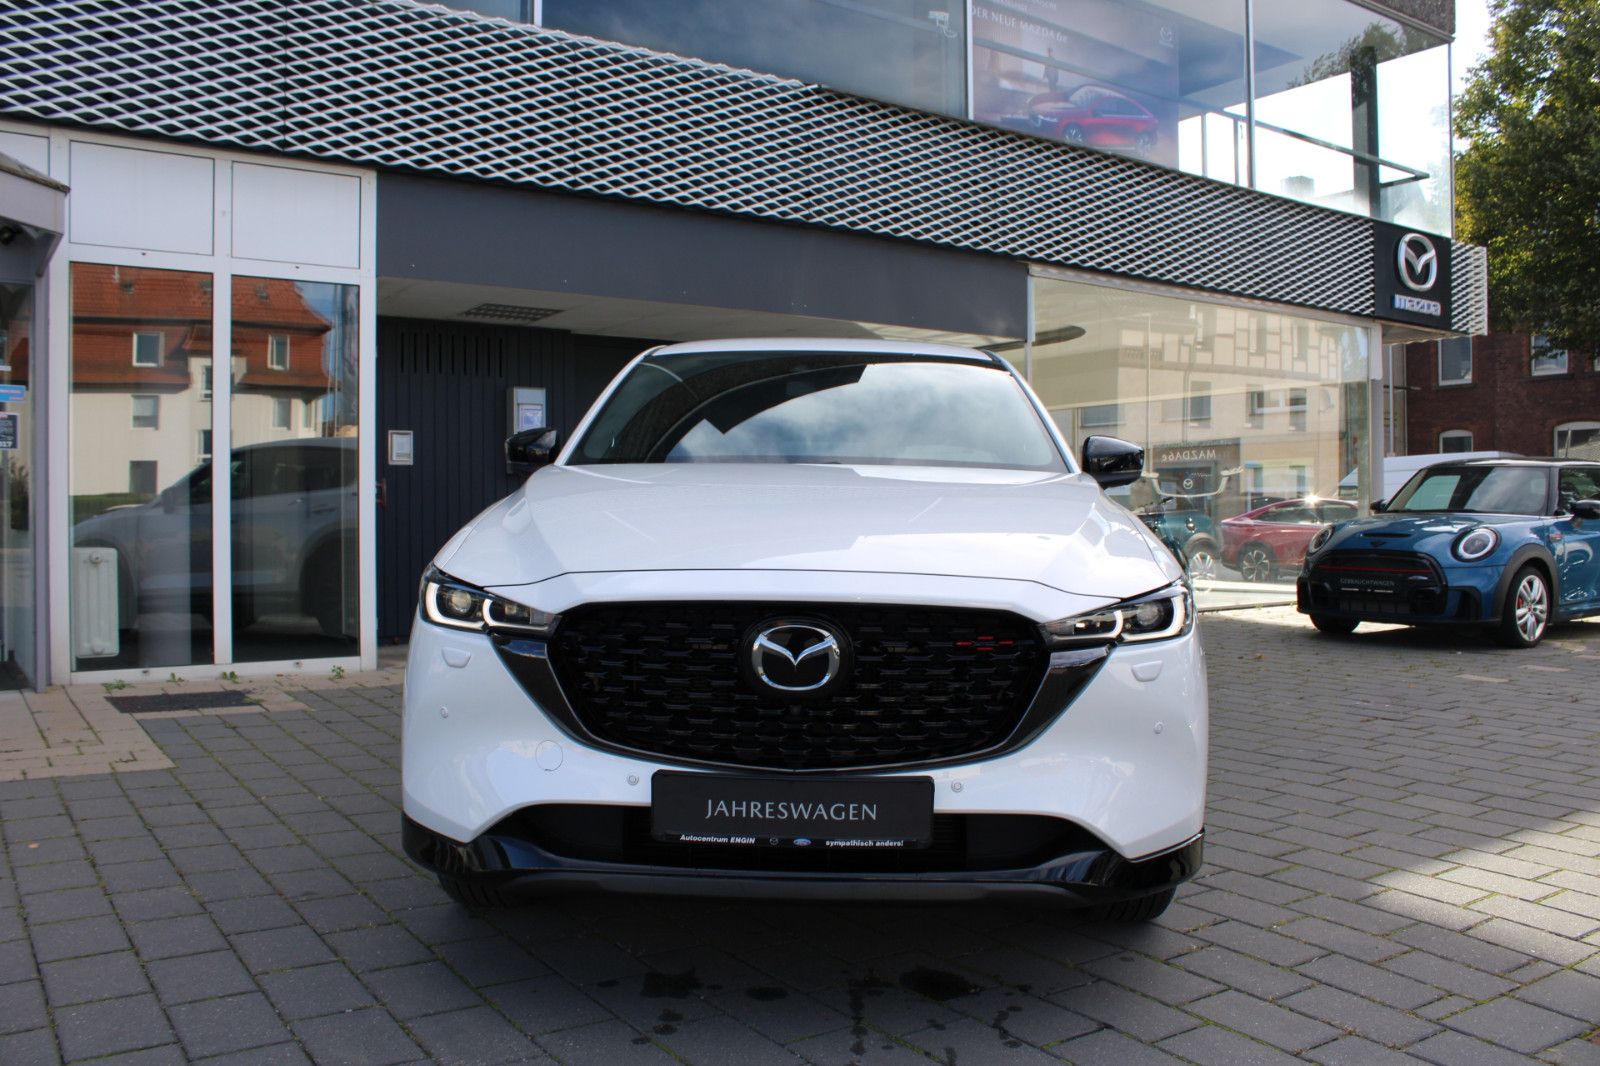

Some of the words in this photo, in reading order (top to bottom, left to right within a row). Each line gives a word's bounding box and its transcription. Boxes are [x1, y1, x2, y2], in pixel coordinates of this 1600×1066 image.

[705, 799, 877, 821] JAHRESWAGEN
[680, 834, 729, 843] Autocentrum
[730, 836, 756, 844] ENGIN
[825, 839, 874, 848] sympathisch
[875, 839, 904, 847] anders!
